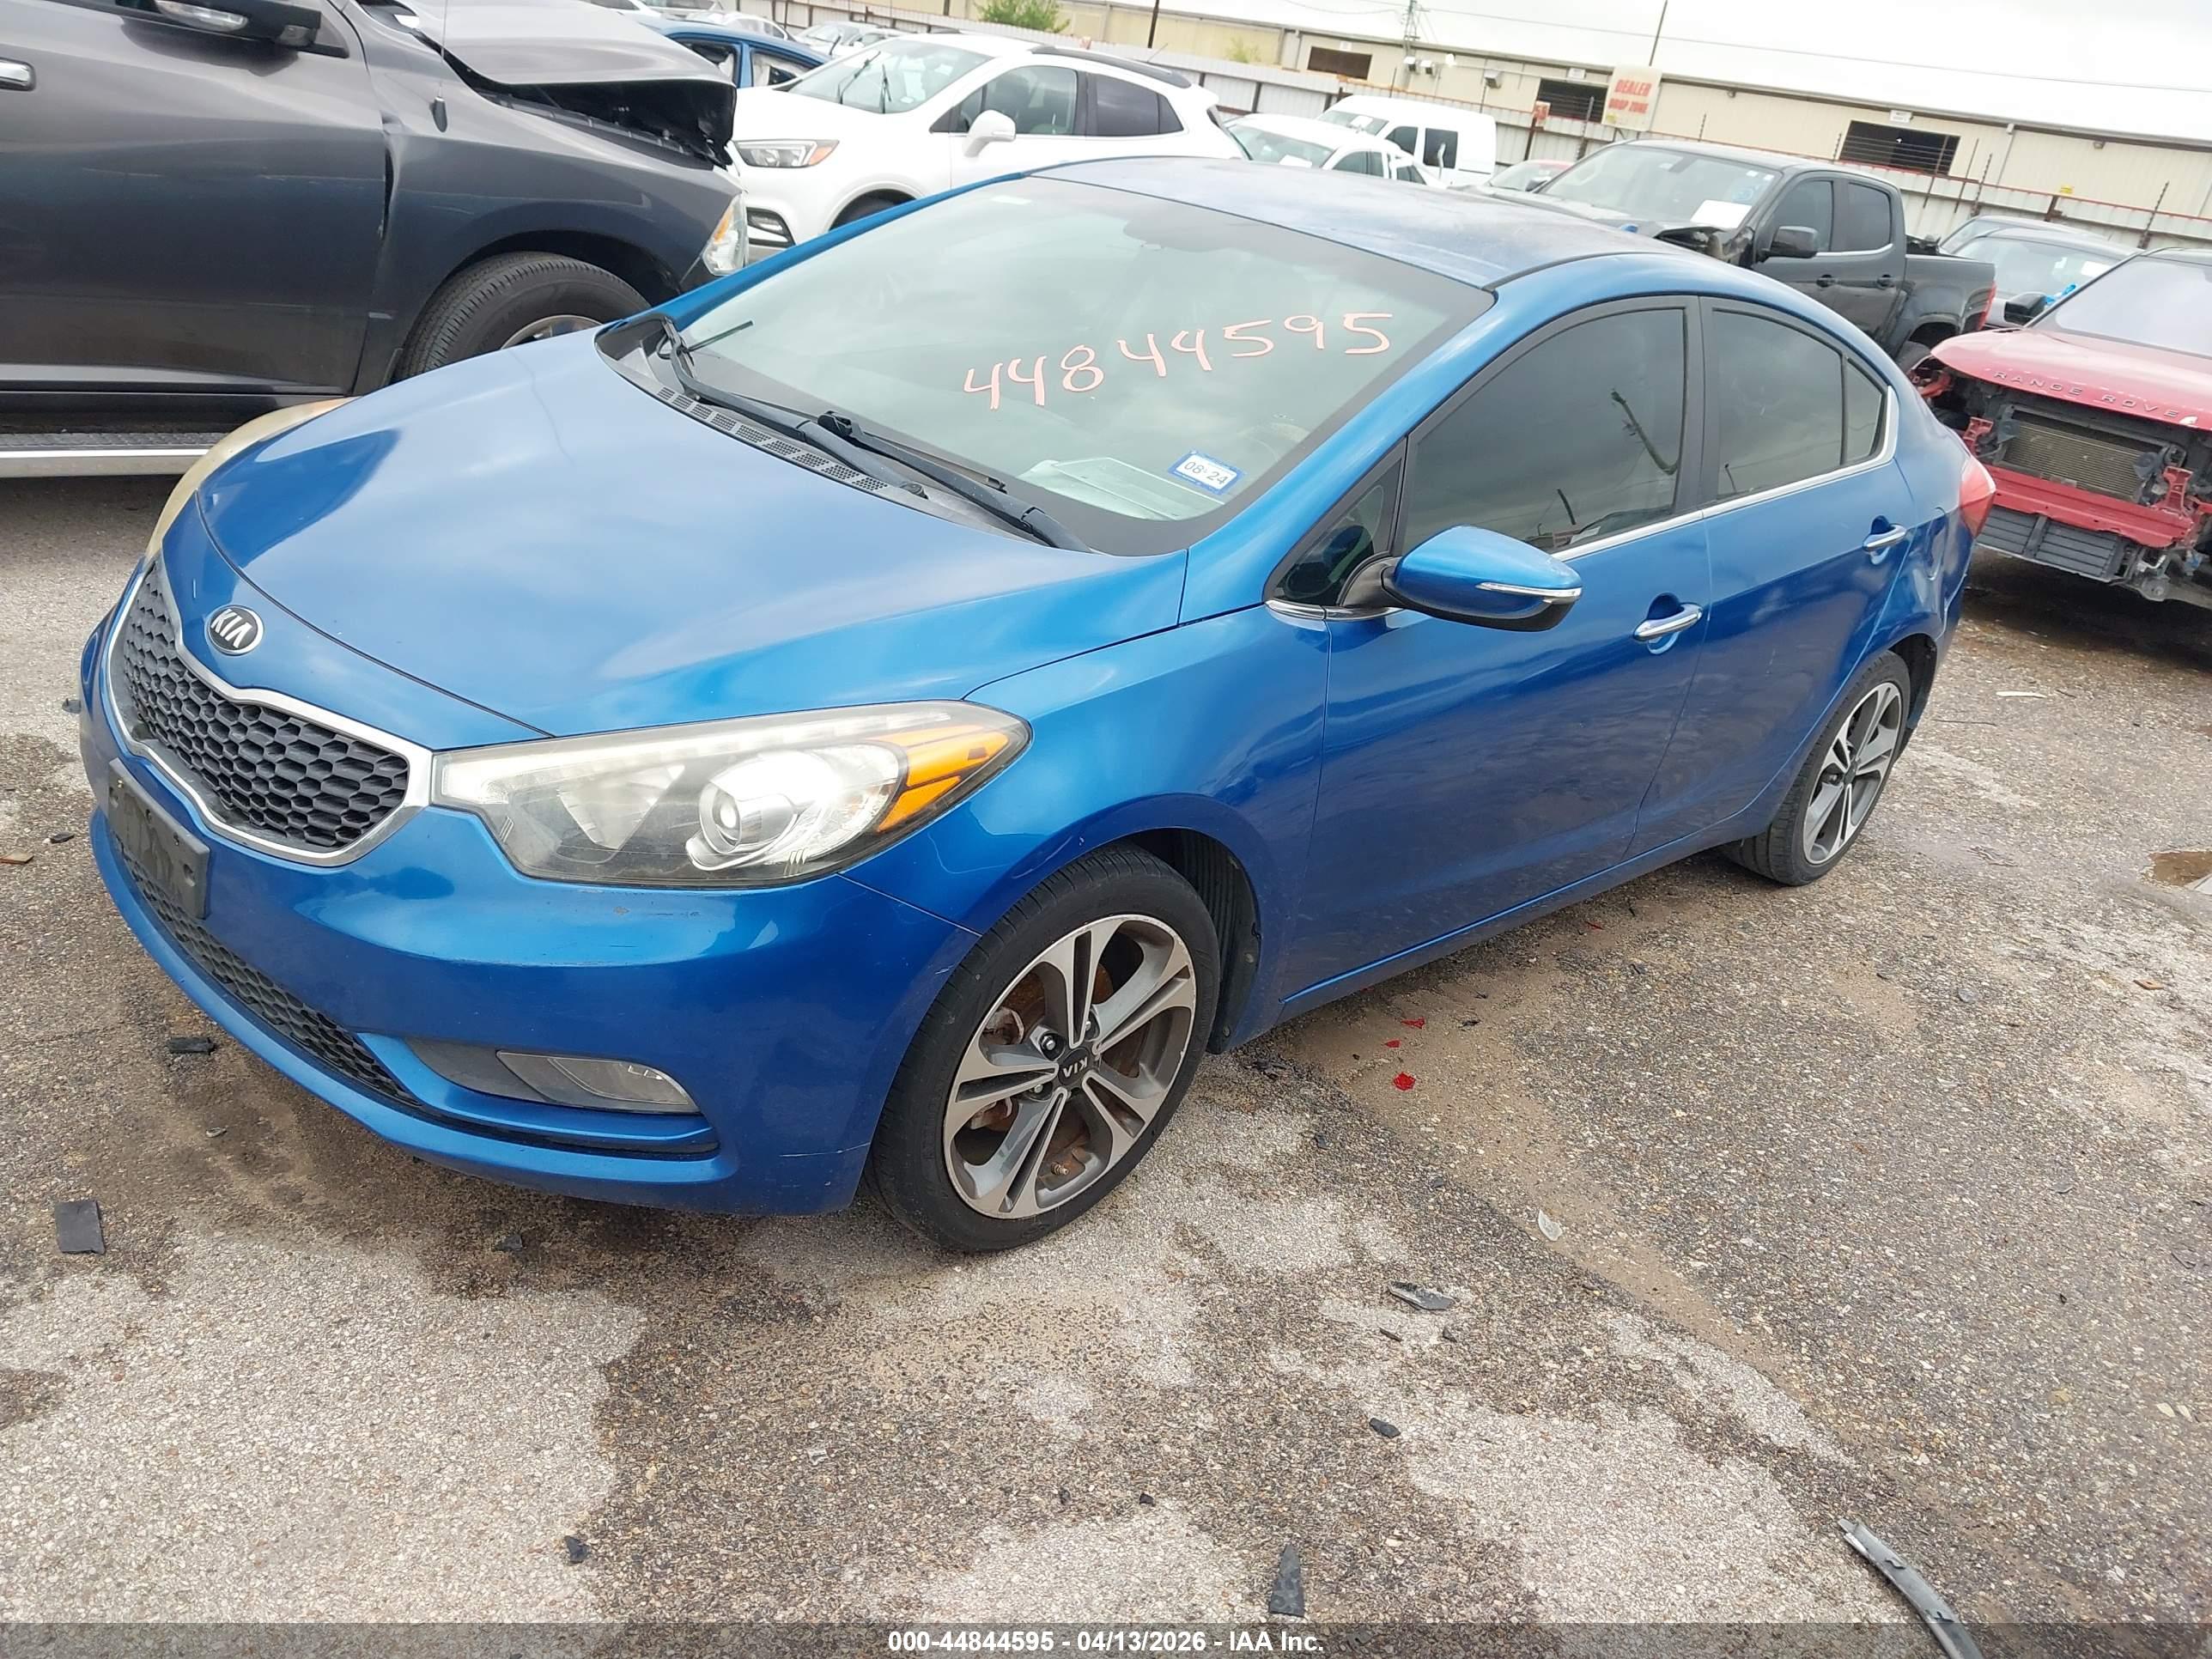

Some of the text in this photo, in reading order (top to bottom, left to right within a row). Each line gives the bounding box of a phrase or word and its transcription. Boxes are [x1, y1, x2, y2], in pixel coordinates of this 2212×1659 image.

[1614, 79, 1653, 96] DEALER
[963, 313, 1393, 410] 44844595
[1993, 371, 2198, 424] RANGE ROVE
[210, 608, 252, 648] KIA
[1062, 1056, 1088, 1078] KIA
